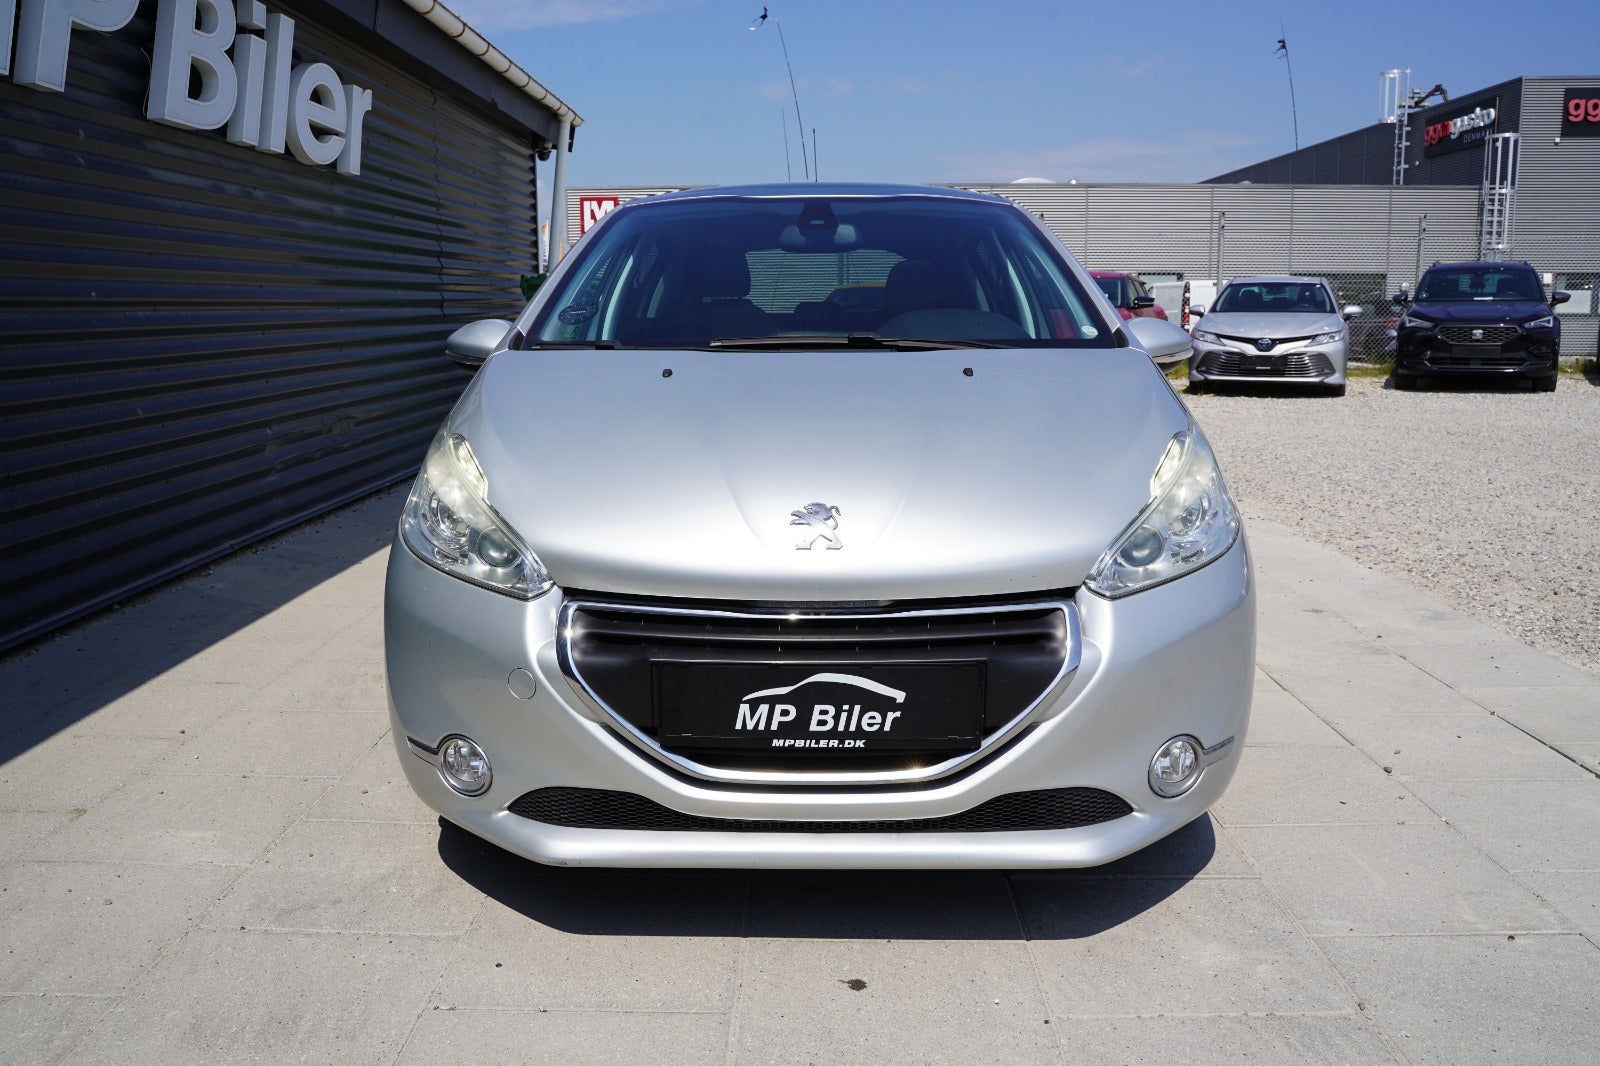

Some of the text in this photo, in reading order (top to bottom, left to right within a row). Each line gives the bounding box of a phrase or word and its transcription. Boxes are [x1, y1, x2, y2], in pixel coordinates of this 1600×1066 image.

[147, 0, 373, 176] Biler
[735, 703, 901, 732] MP Biler
[772, 738, 866, 748] MPBILER.DK
